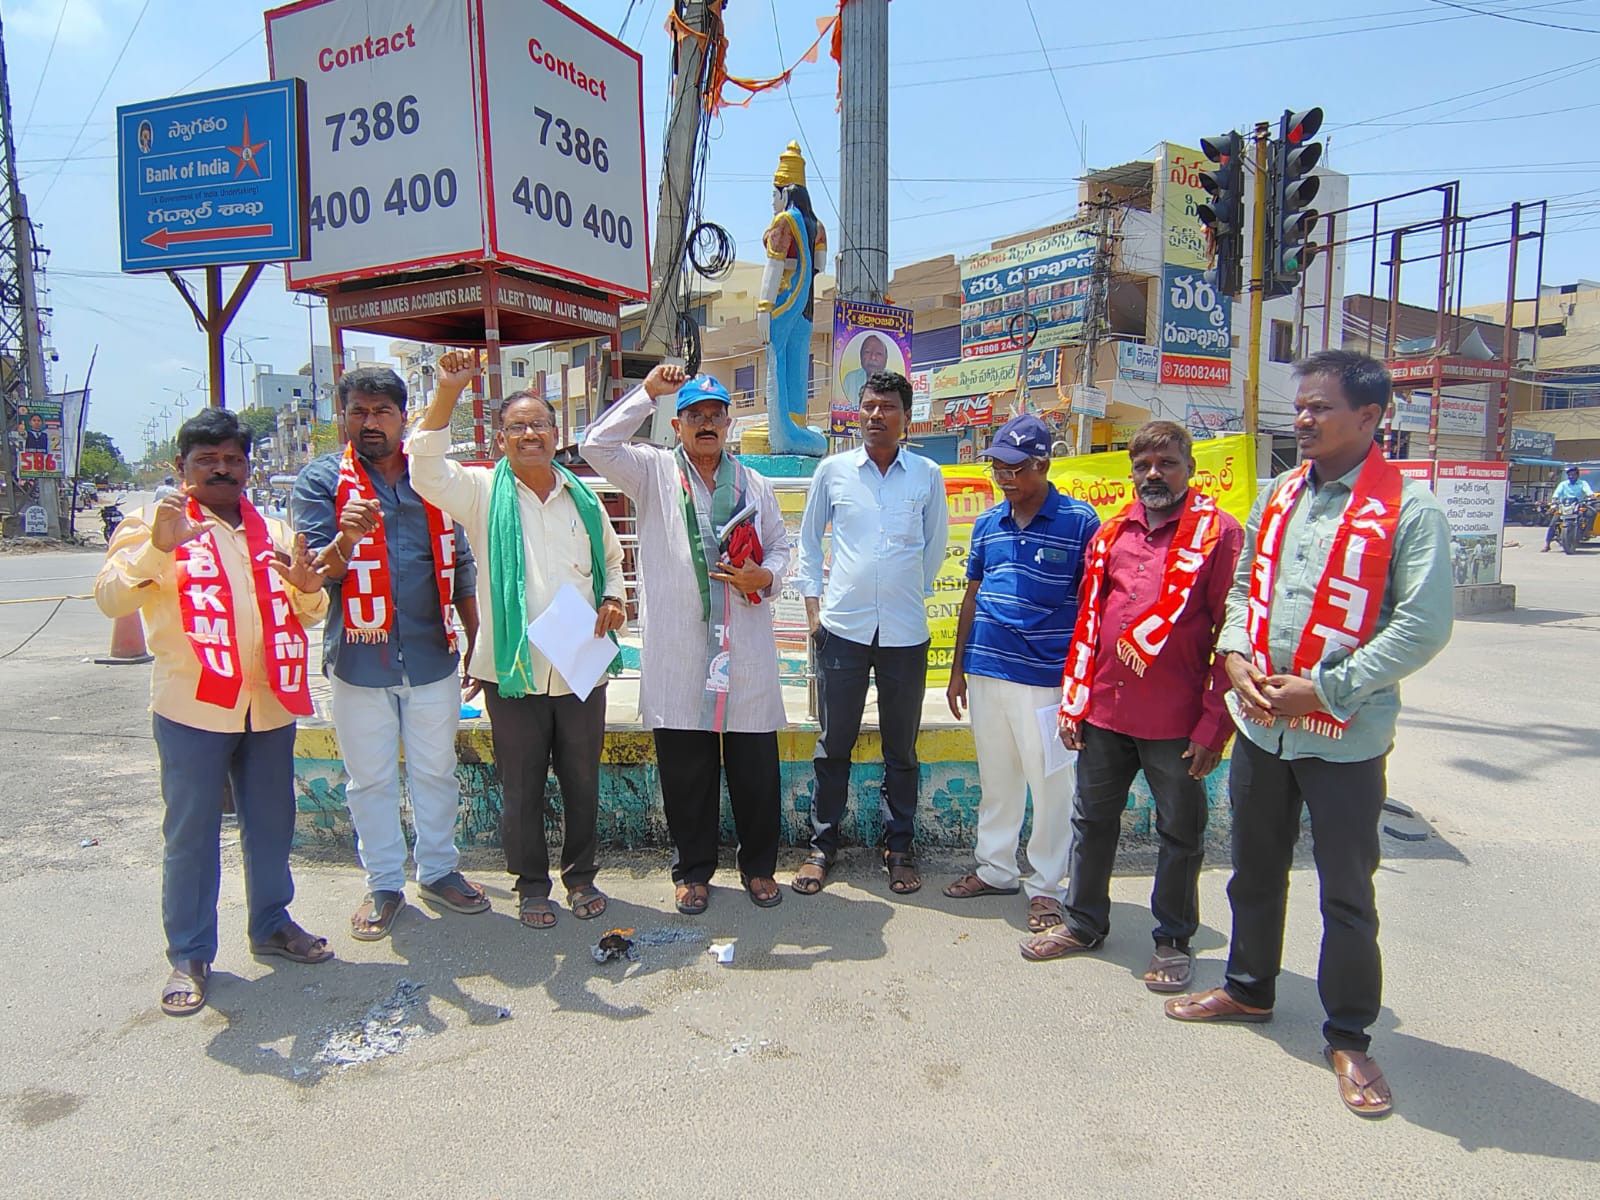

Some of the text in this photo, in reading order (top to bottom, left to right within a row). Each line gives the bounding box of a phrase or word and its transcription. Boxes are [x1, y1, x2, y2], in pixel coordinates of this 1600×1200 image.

[318, 23, 416, 73] Contact
[528, 38, 607, 102] Contact
[168, 116, 228, 142] స్వాగతం
[325, 94, 420, 152] 7386
[533, 105, 609, 173] 7386
[146, 158, 230, 183] Bank of India
[147, 201, 264, 225] గద్వాల్ శాఖ
[310, 168, 457, 232] 400 400
[512, 176, 634, 251] 400 400
[970, 274, 1007, 296] చర్మ
[331, 285, 482, 322] LITTLE CARE MAKES ACCIDENTS RARE
[498, 289, 618, 329] ALERT TODAY ALIVE TOMORROW
[1171, 274, 1224, 326] చర్మ
[1164, 321, 1230, 349] దవాఖాన
[1173, 363, 1229, 381] 7680824411
[1389, 365, 1434, 378] EED NEXT
[945, 396, 990, 413] STING
[21, 452, 56, 471] 586
[926, 649, 955, 667] 984
